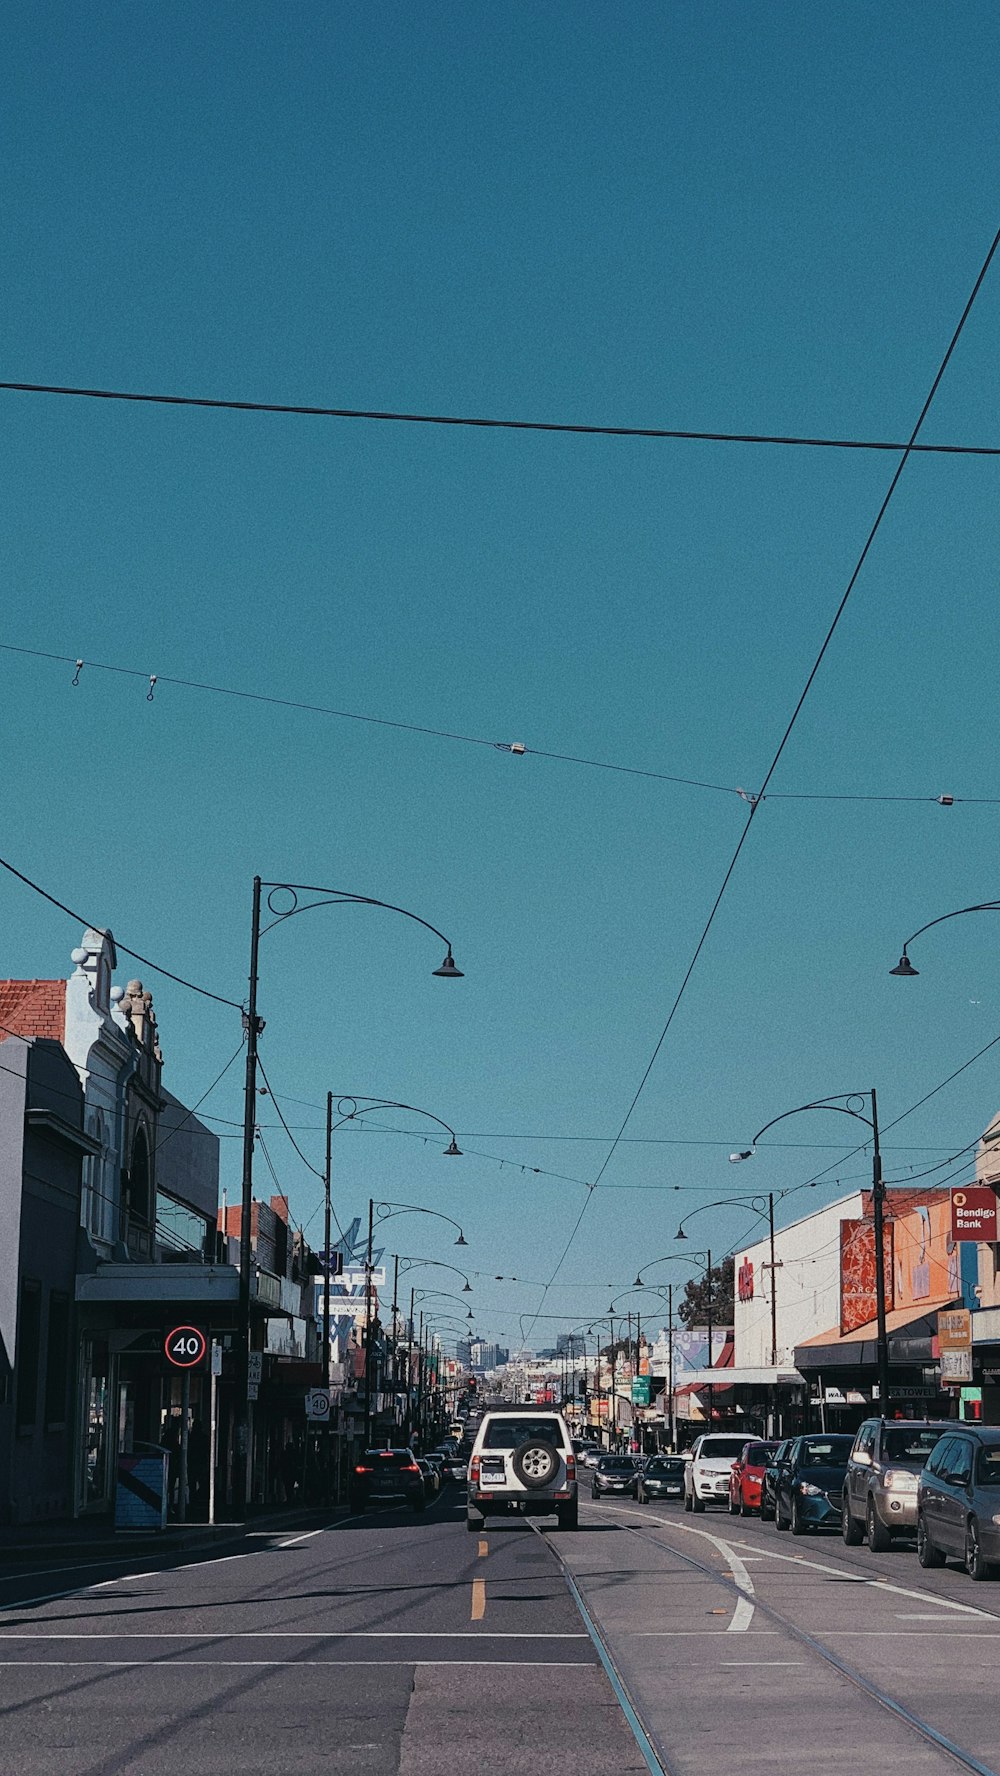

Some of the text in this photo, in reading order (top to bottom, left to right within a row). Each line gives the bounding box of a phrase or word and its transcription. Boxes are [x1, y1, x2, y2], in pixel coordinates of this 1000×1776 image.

[956, 1208, 996, 1219] Bendigo
[956, 1219, 982, 1228] Bank
[850, 1286, 892, 1294] ARCAE
[172, 1337, 199, 1355] 40
[903, 1388, 933, 1397] TOWEL
[312, 1399, 326, 1410] 40
